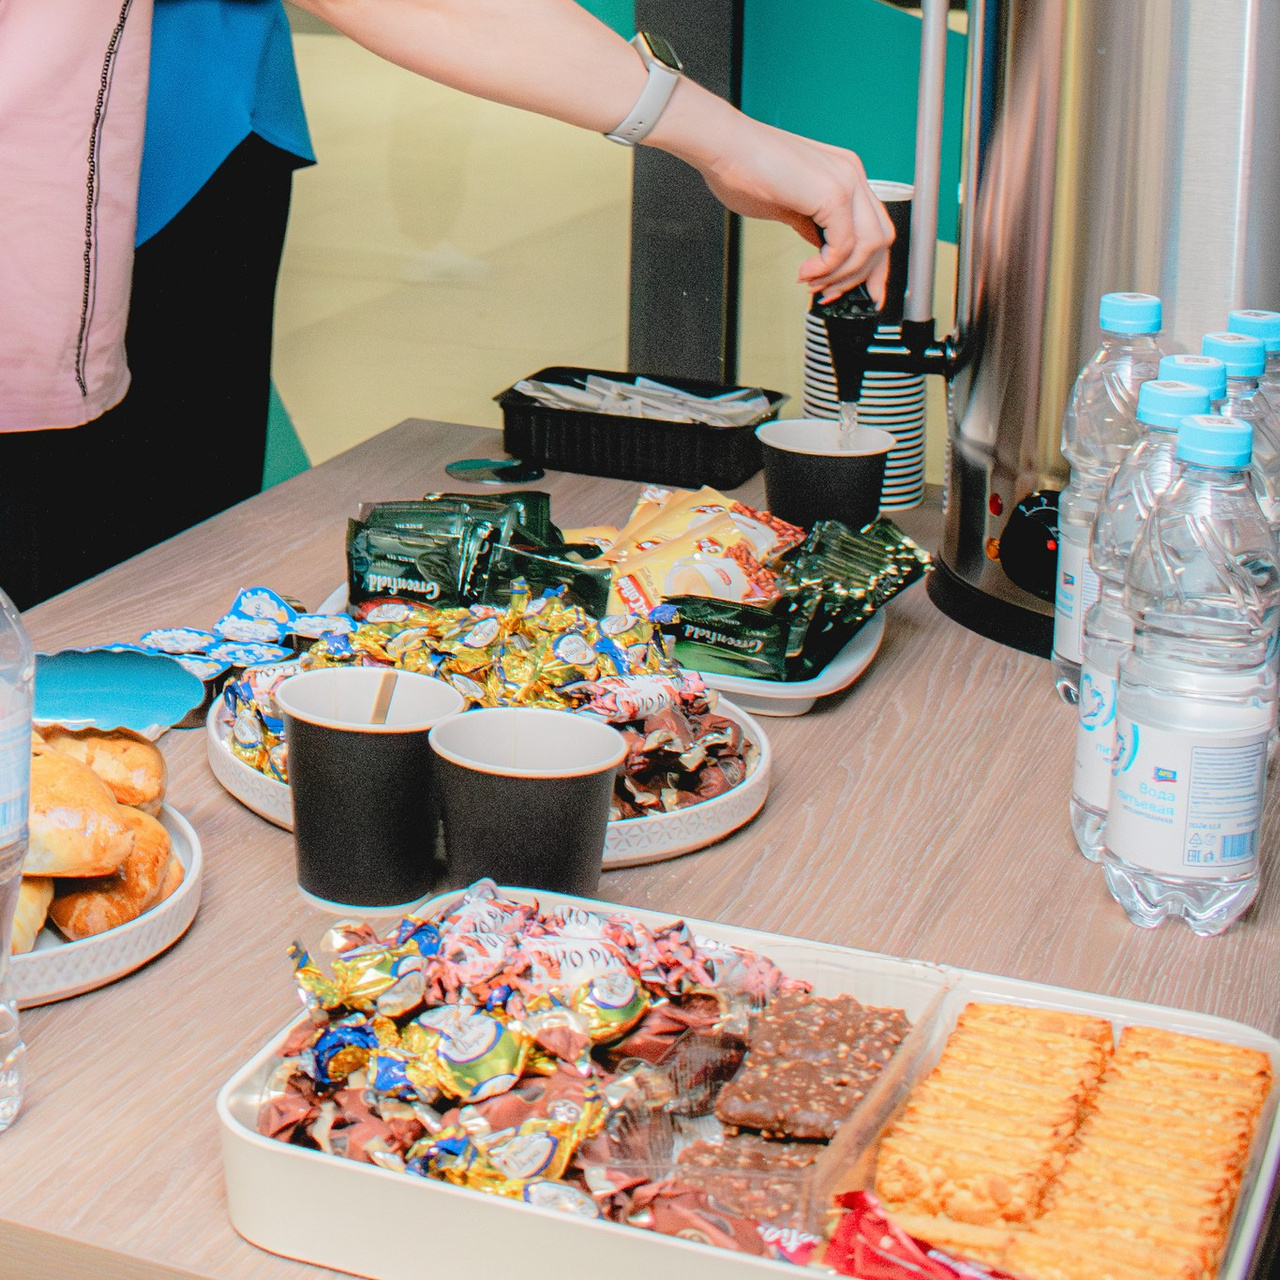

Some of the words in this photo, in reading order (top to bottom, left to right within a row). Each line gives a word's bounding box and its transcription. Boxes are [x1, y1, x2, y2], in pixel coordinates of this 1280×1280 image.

[366, 573, 441, 601] Greenfield
[683, 623, 765, 654] Greenfield
[1139, 782, 1176, 802] Вода
